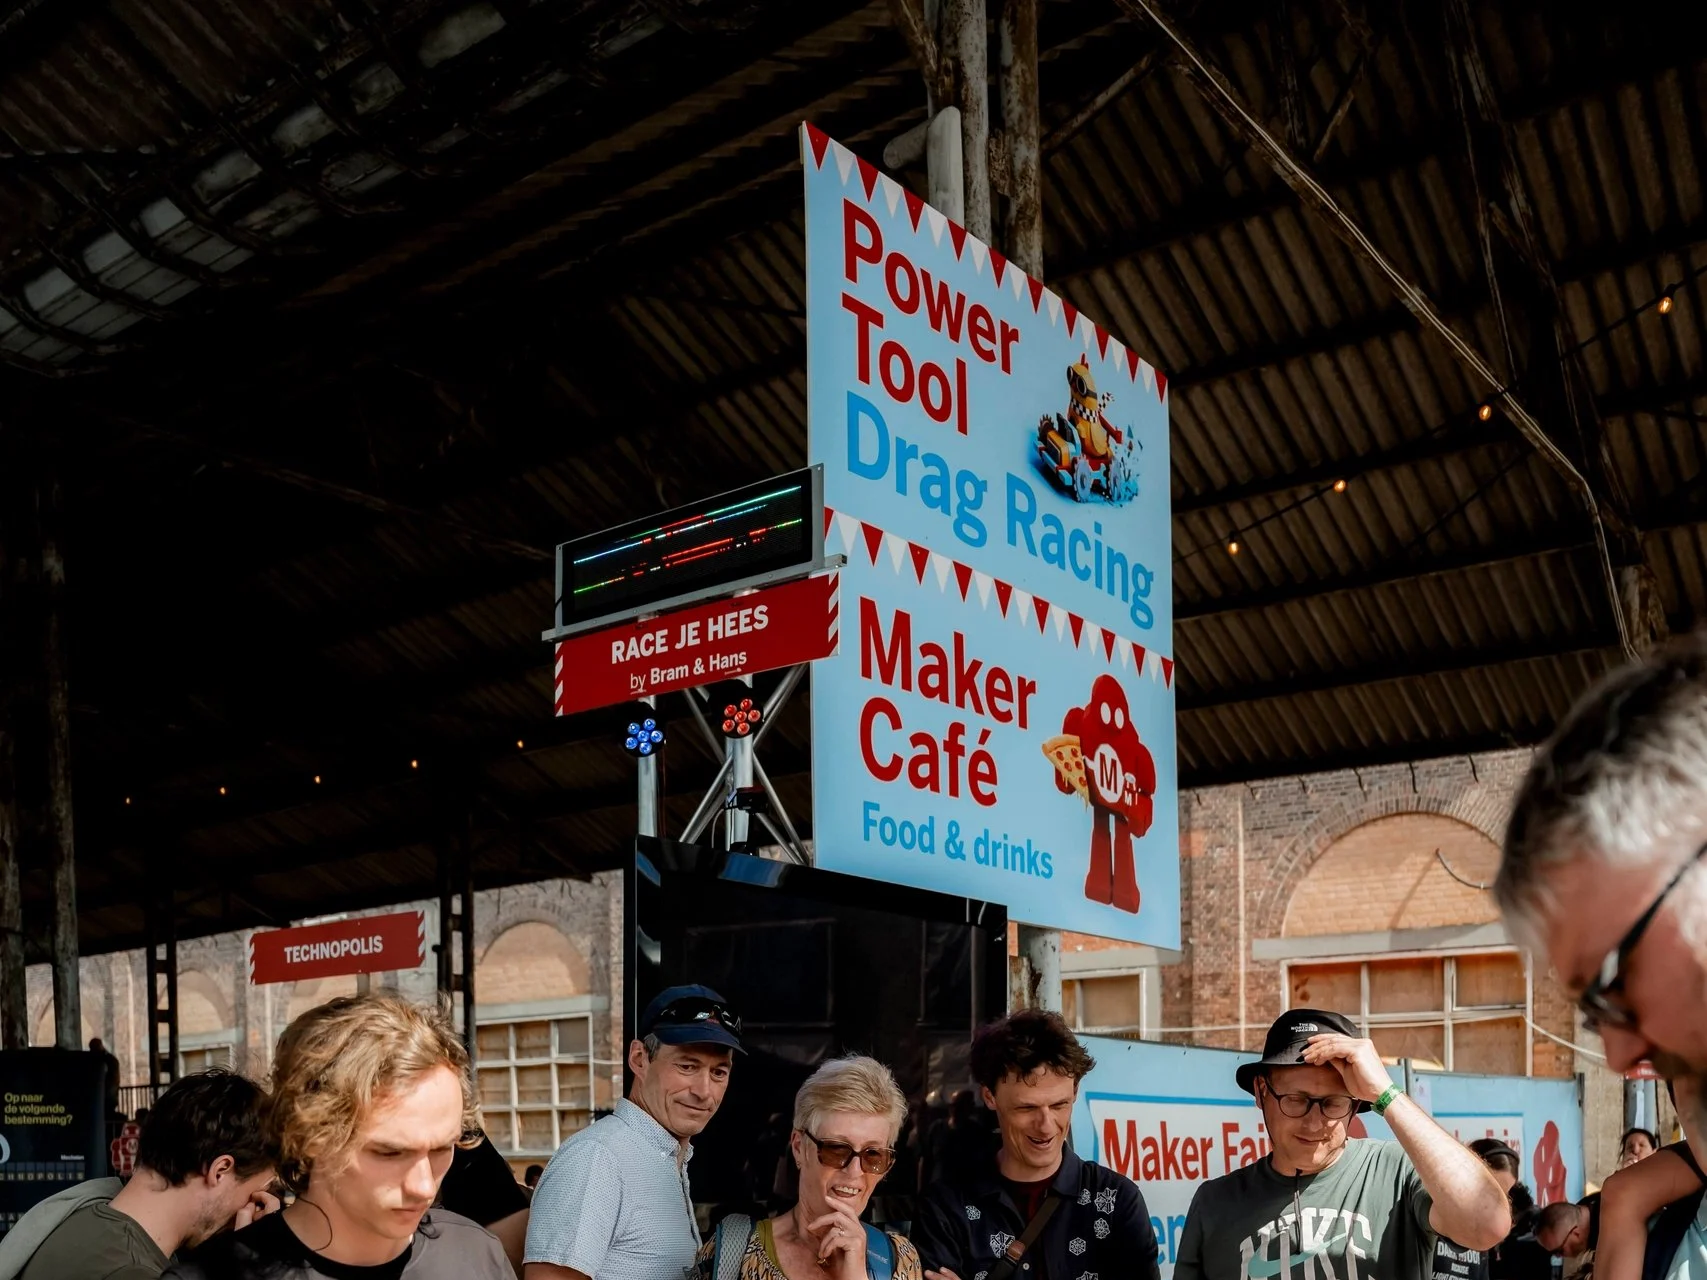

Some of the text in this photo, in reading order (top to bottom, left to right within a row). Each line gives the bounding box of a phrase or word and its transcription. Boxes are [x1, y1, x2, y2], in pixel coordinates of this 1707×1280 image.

[843, 198, 1020, 375] Power
[841, 292, 968, 436] Tool
[847, 391, 1154, 630] Drag Racing
[611, 604, 769, 664] RACE JE HEES
[859, 596, 1037, 730] Maker
[630, 651, 747, 692] by Bram & Hans
[859, 697, 998, 807] Café
[1099, 752, 1118, 794] M
[863, 800, 1054, 880] Food & drinks
[284, 935, 384, 964] TECHNOPOLIS
[4, 1092, 44, 1104] Op naar
[4, 1103, 65, 1115] de volgende
[4, 1114, 73, 1127] bestemming?
[1103, 1118, 1273, 1182] Maker Fai
